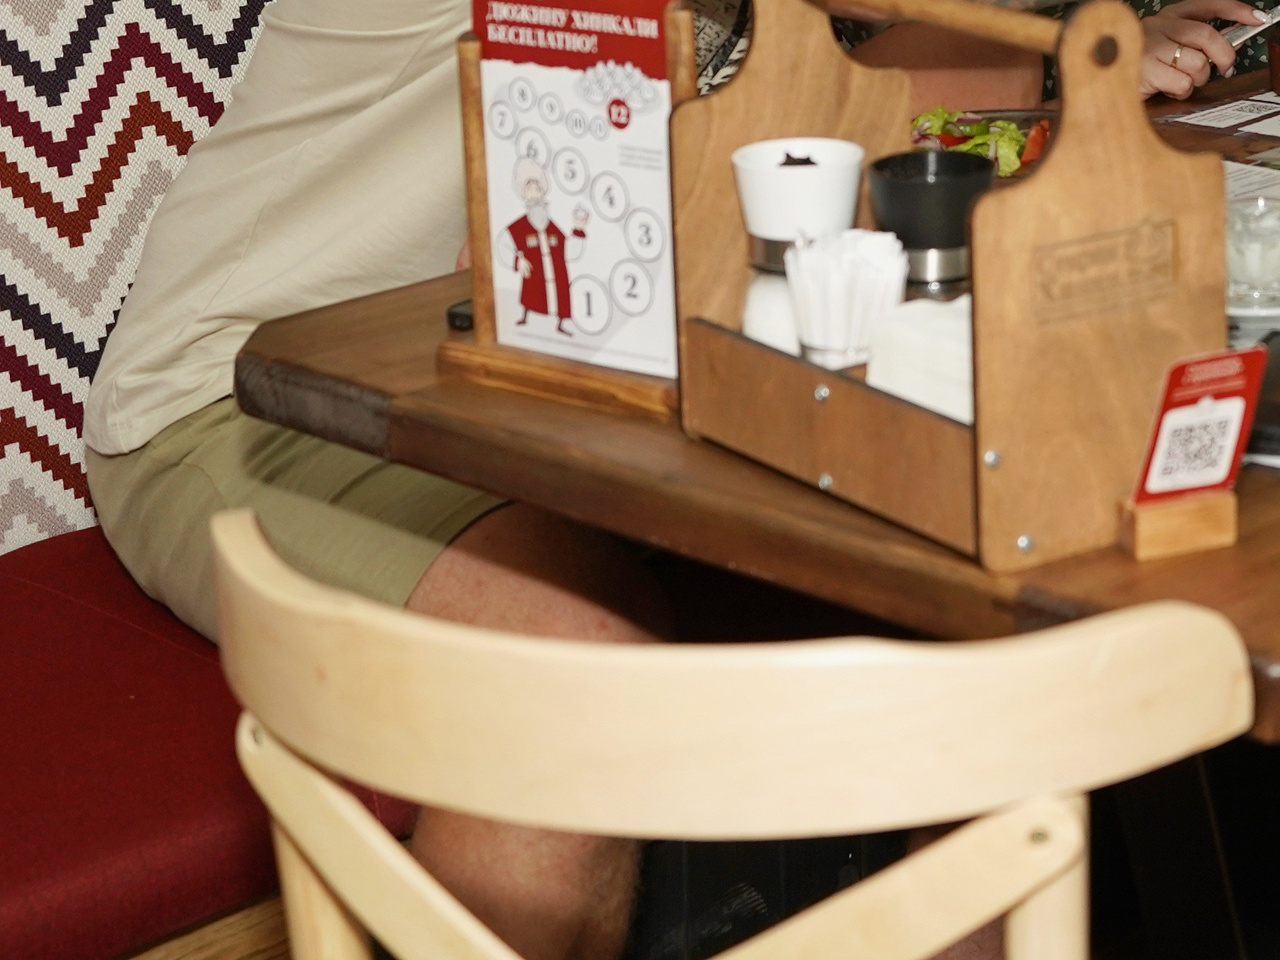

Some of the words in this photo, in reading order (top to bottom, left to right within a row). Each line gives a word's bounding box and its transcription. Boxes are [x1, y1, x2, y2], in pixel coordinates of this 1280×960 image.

[486, 0, 569, 28] ДЮЖИНУ
[571, 10, 659, 38] ХИНКАЛИ
[487, 23, 599, 54] БЕСПЛАТНО!
[637, 223, 652, 247] 3
[624, 272, 640, 300] 2
[584, 291, 593, 319] 1
